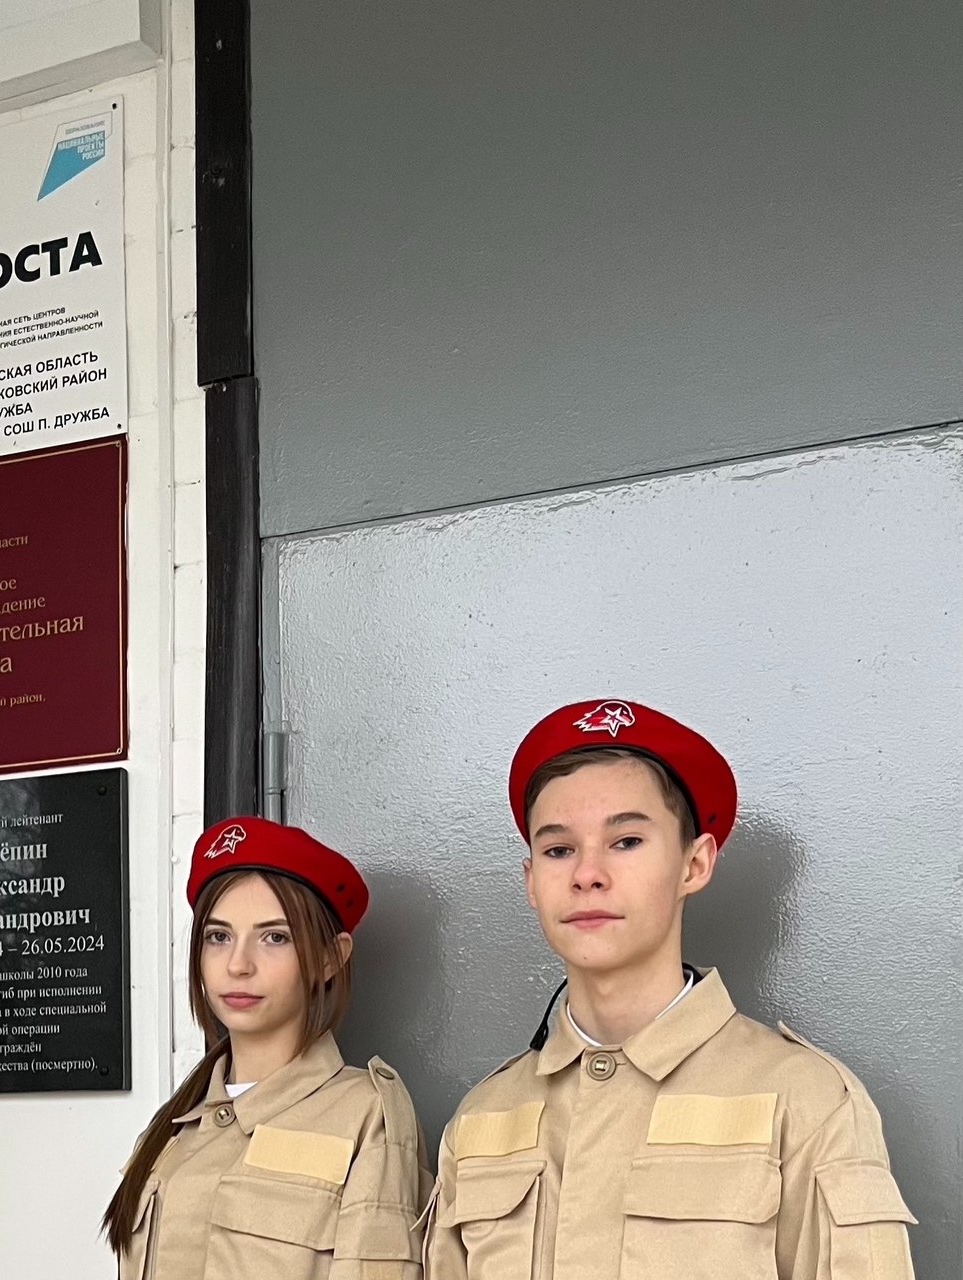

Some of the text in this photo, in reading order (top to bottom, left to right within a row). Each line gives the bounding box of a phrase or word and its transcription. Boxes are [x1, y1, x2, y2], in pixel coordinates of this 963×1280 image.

[14, 315, 31, 325] СЕТЬ
[33, 307, 65, 321] ЦЕНТРОВ
[14, 310, 99, 335] ЕСТЕСТВЕННО-НАУЧНОЙ
[38, 322, 103, 341] НАПРАВЛЕННОСТИ
[36, 352, 98, 372] ОБЛАСТЬ
[62, 368, 107, 387] РАЙОН
[4, 421, 34, 436] СОШ
[39, 419, 51, 430] П.
[54, 407, 110, 429] ДРУЖБА
[10, 694, 46, 707] район,
[10, 813, 63, 827] лейтенант
[22, 935, 104, 955] 26.05.2024
[0, 970, 34, 981] школы
[37, 966, 61, 979] 2010
[65, 967, 87, 978] года
[17, 988, 36, 1001] при
[39, 985, 102, 998] исполнении
[4, 1008, 10, 1017] в
[13, 1005, 36, 1017] ходе
[39, 1001, 107, 1015] специальной
[11, 1024, 60, 1037] операции
[31, 1057, 98, 1072] (посмертно).
